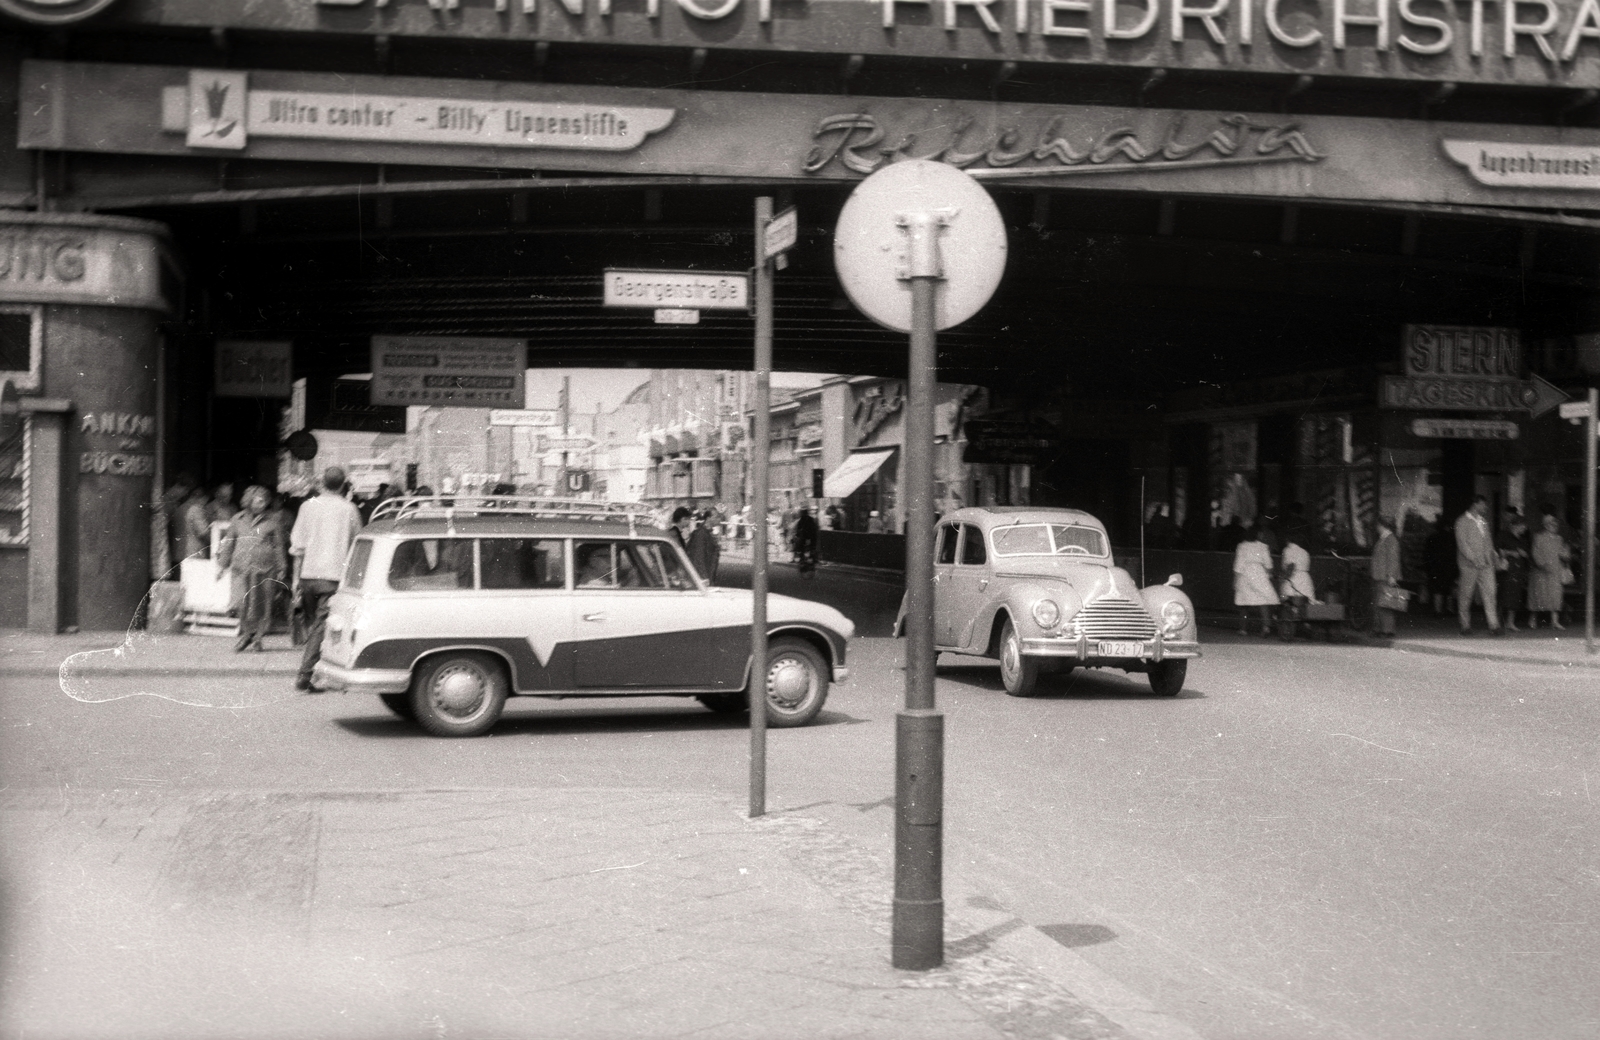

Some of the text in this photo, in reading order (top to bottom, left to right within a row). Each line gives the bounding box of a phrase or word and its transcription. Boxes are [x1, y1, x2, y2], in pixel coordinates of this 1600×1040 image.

[614, 276, 739, 301] Georgenstraße
[1411, 327, 1519, 376] STERN
[569, 473, 584, 490] U
